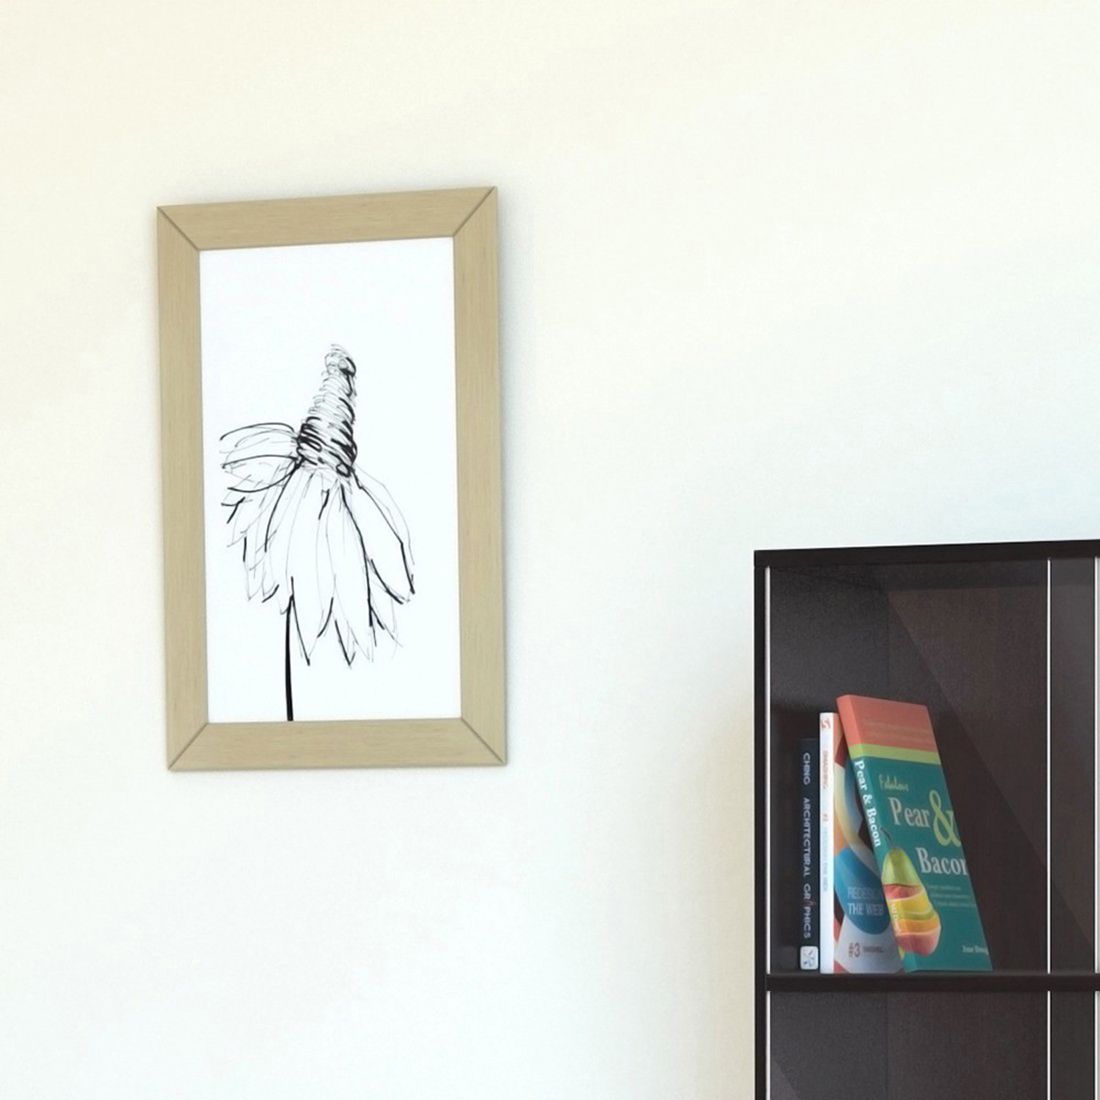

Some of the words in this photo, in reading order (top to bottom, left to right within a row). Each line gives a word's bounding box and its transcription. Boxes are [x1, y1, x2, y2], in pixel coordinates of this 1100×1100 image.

[803, 752, 811, 785] CHING
[854, 759, 868, 791] Pear
[862, 794, 873, 805] &
[888, 797, 931, 828] Pear
[929, 789, 961, 847] &
[803, 797, 811, 877] ARCHITECTURAL
[865, 807, 881, 848] Bacon
